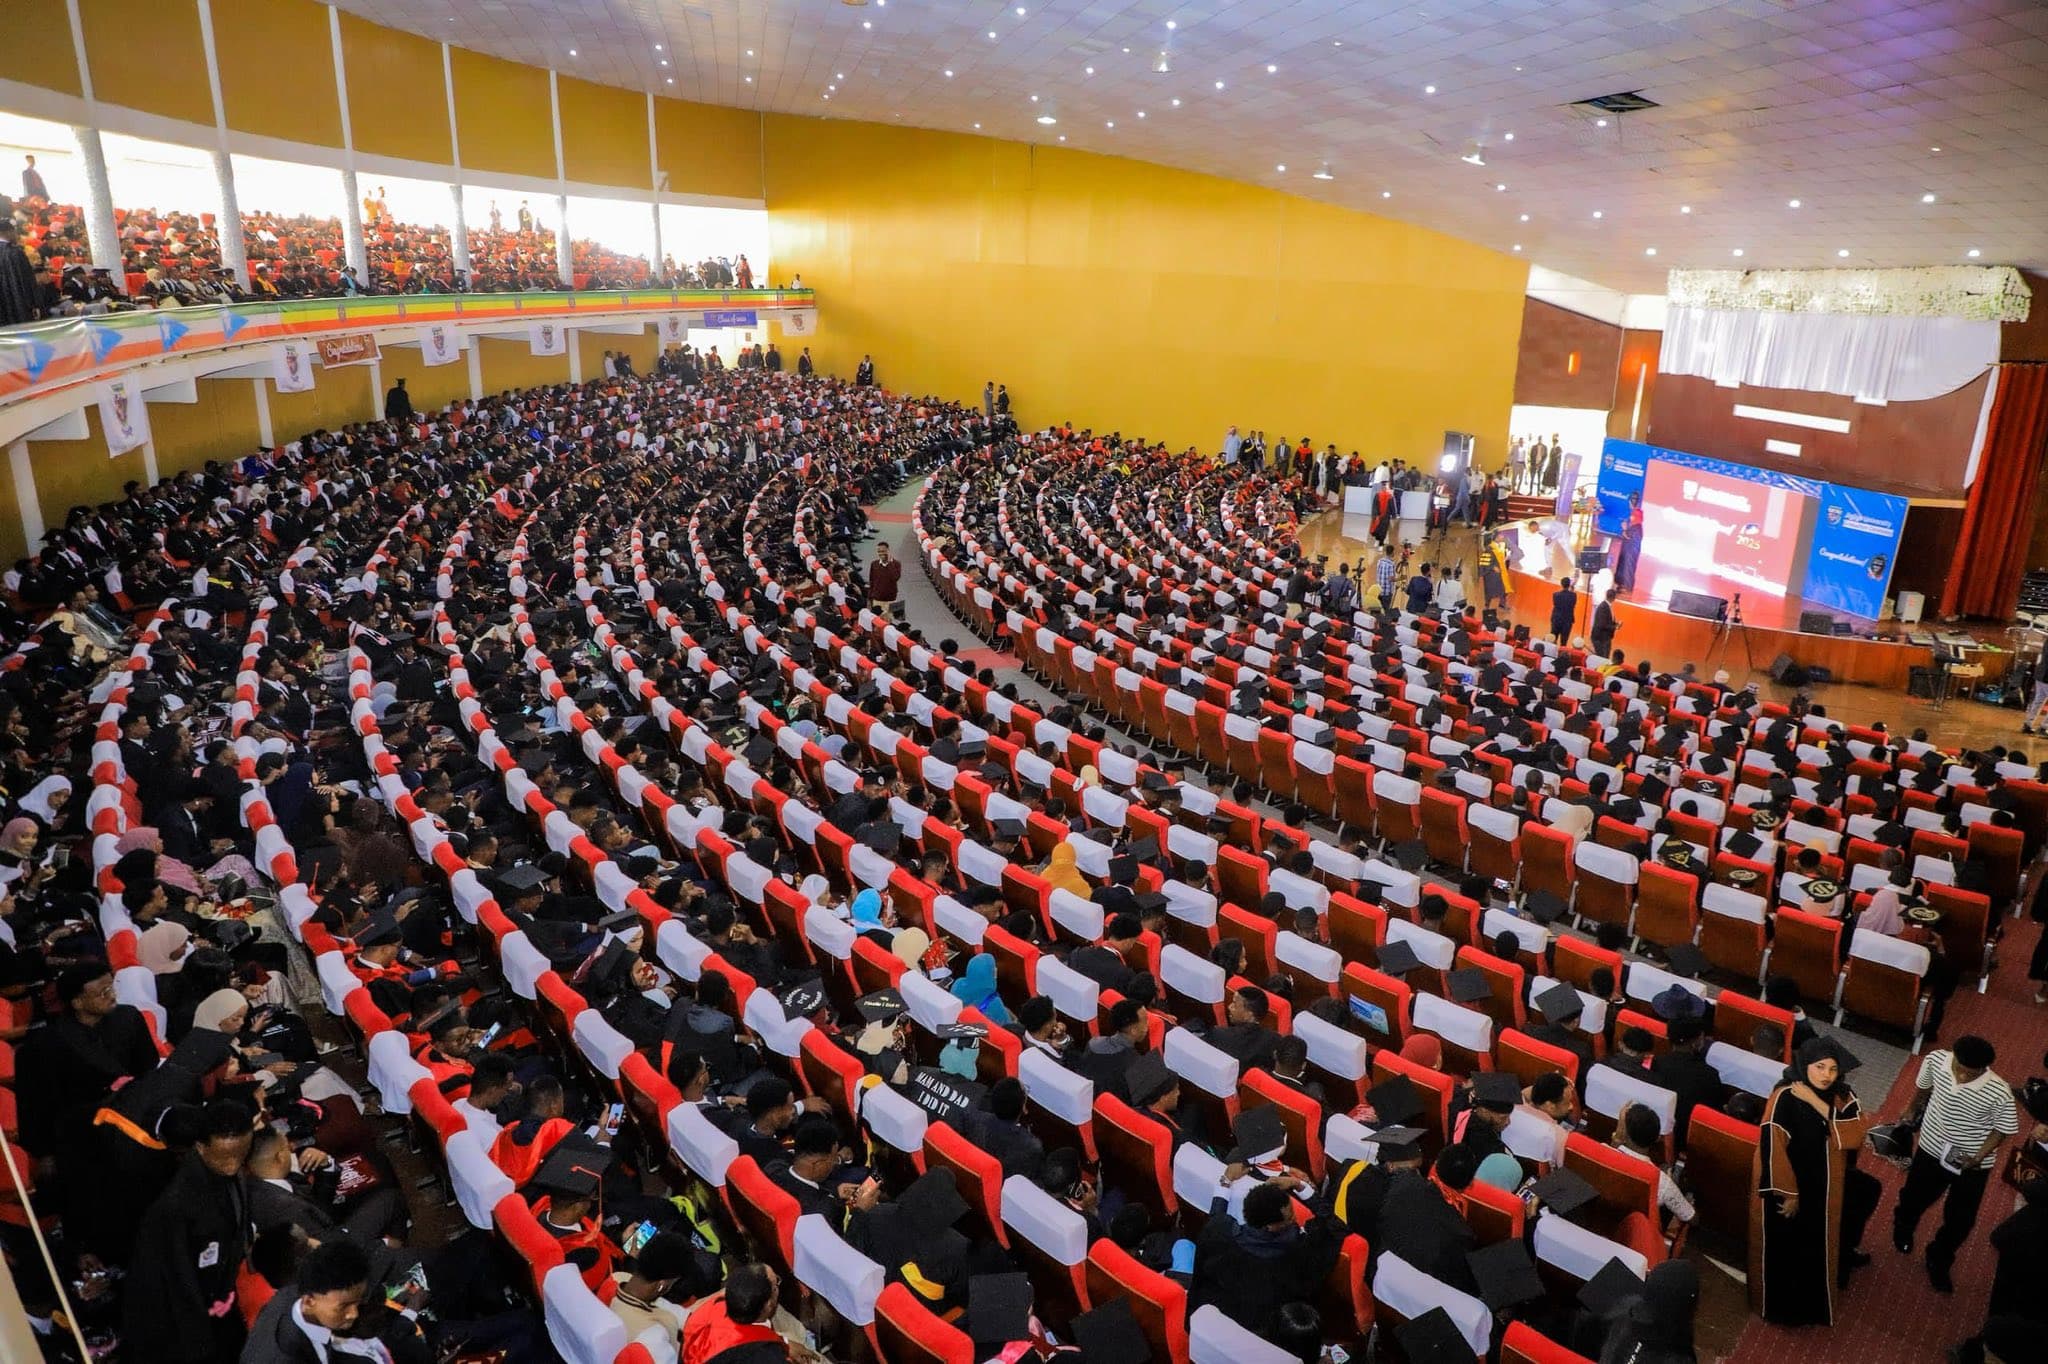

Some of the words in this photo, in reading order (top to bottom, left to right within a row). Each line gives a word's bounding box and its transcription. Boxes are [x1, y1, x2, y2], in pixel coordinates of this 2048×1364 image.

[917, 1090, 925, 1103] I
[922, 1093, 939, 1111] DID
[937, 1100, 951, 1117] IT
[932, 1080, 951, 1098] AND
[949, 1090, 970, 1109] DAD
